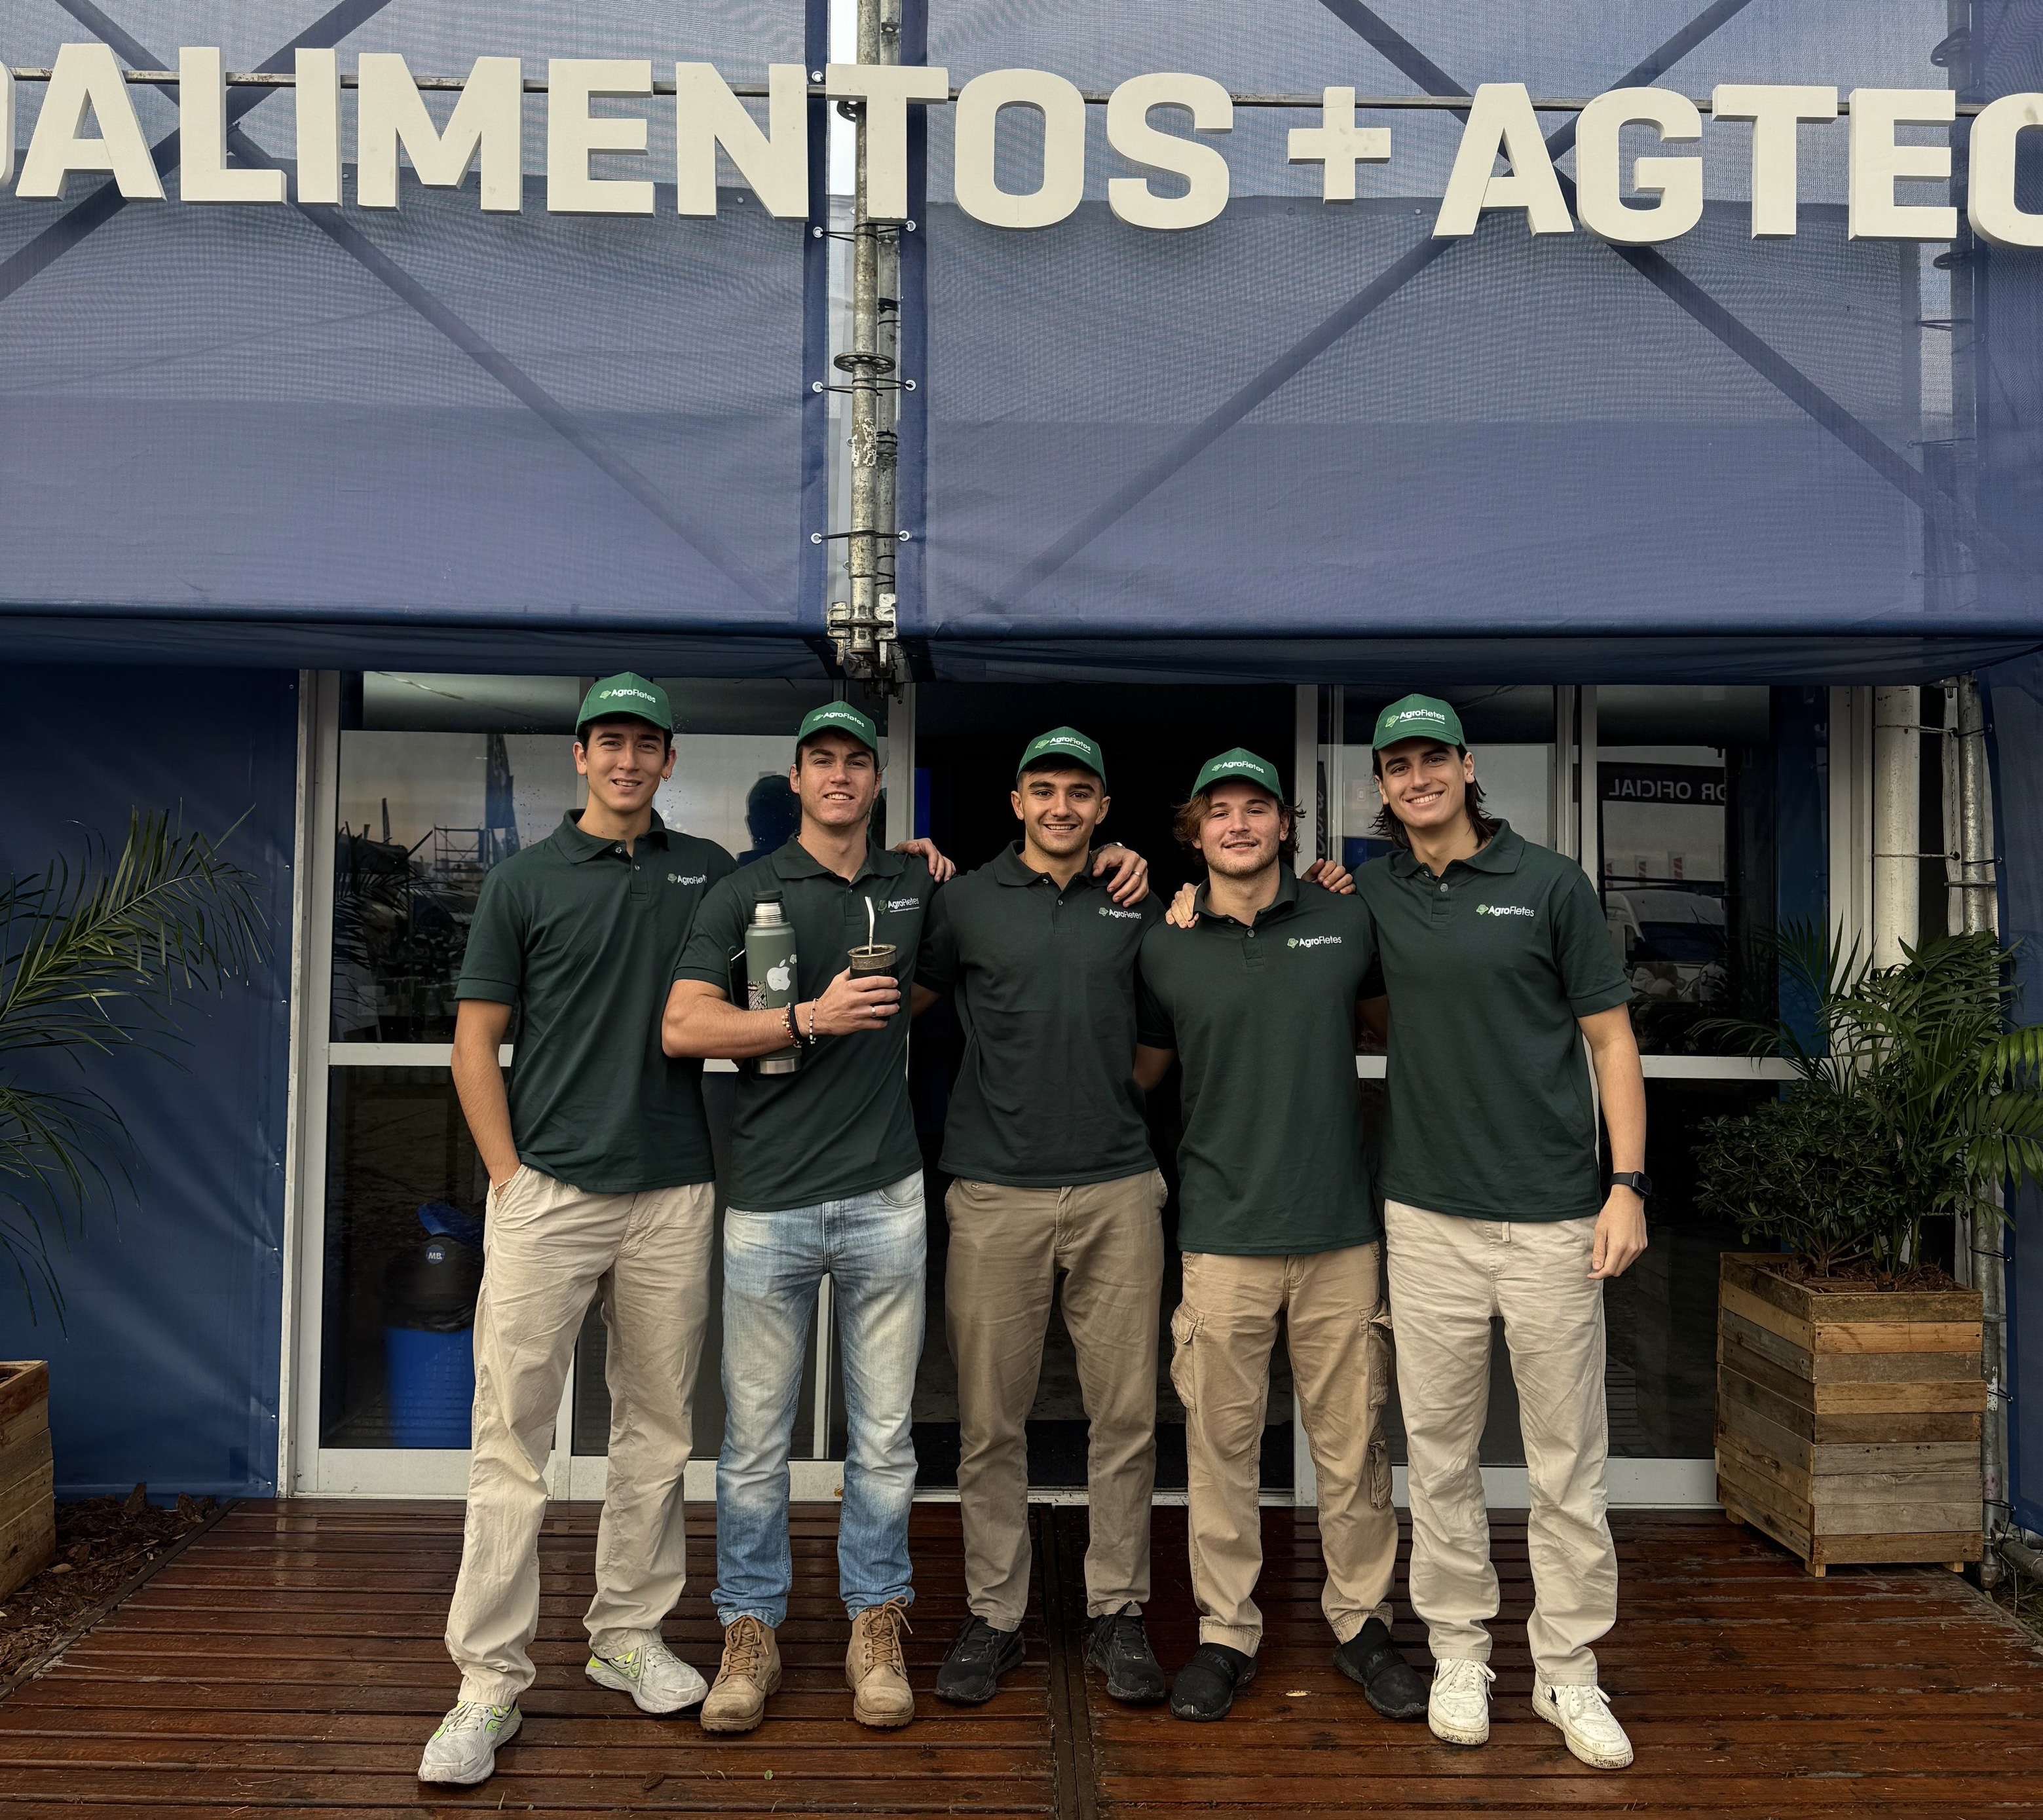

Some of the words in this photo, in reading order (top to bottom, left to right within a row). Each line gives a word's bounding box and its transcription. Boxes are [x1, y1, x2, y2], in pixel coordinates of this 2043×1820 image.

[0, 43, 1233, 231] ALIMENTOS
[1288, 86, 1391, 204] +
[610, 688, 656, 703] AgroFletes
[1399, 709, 1445, 721] AgroFletes
[1222, 760, 1265, 773] AgroFletes
[888, 897, 920, 909] AgroFletes
[1108, 908, 1142, 919] AgroFletes
[1488, 905, 1535, 917] AgroFletes
[1299, 935, 1342, 948] AgroFletes
